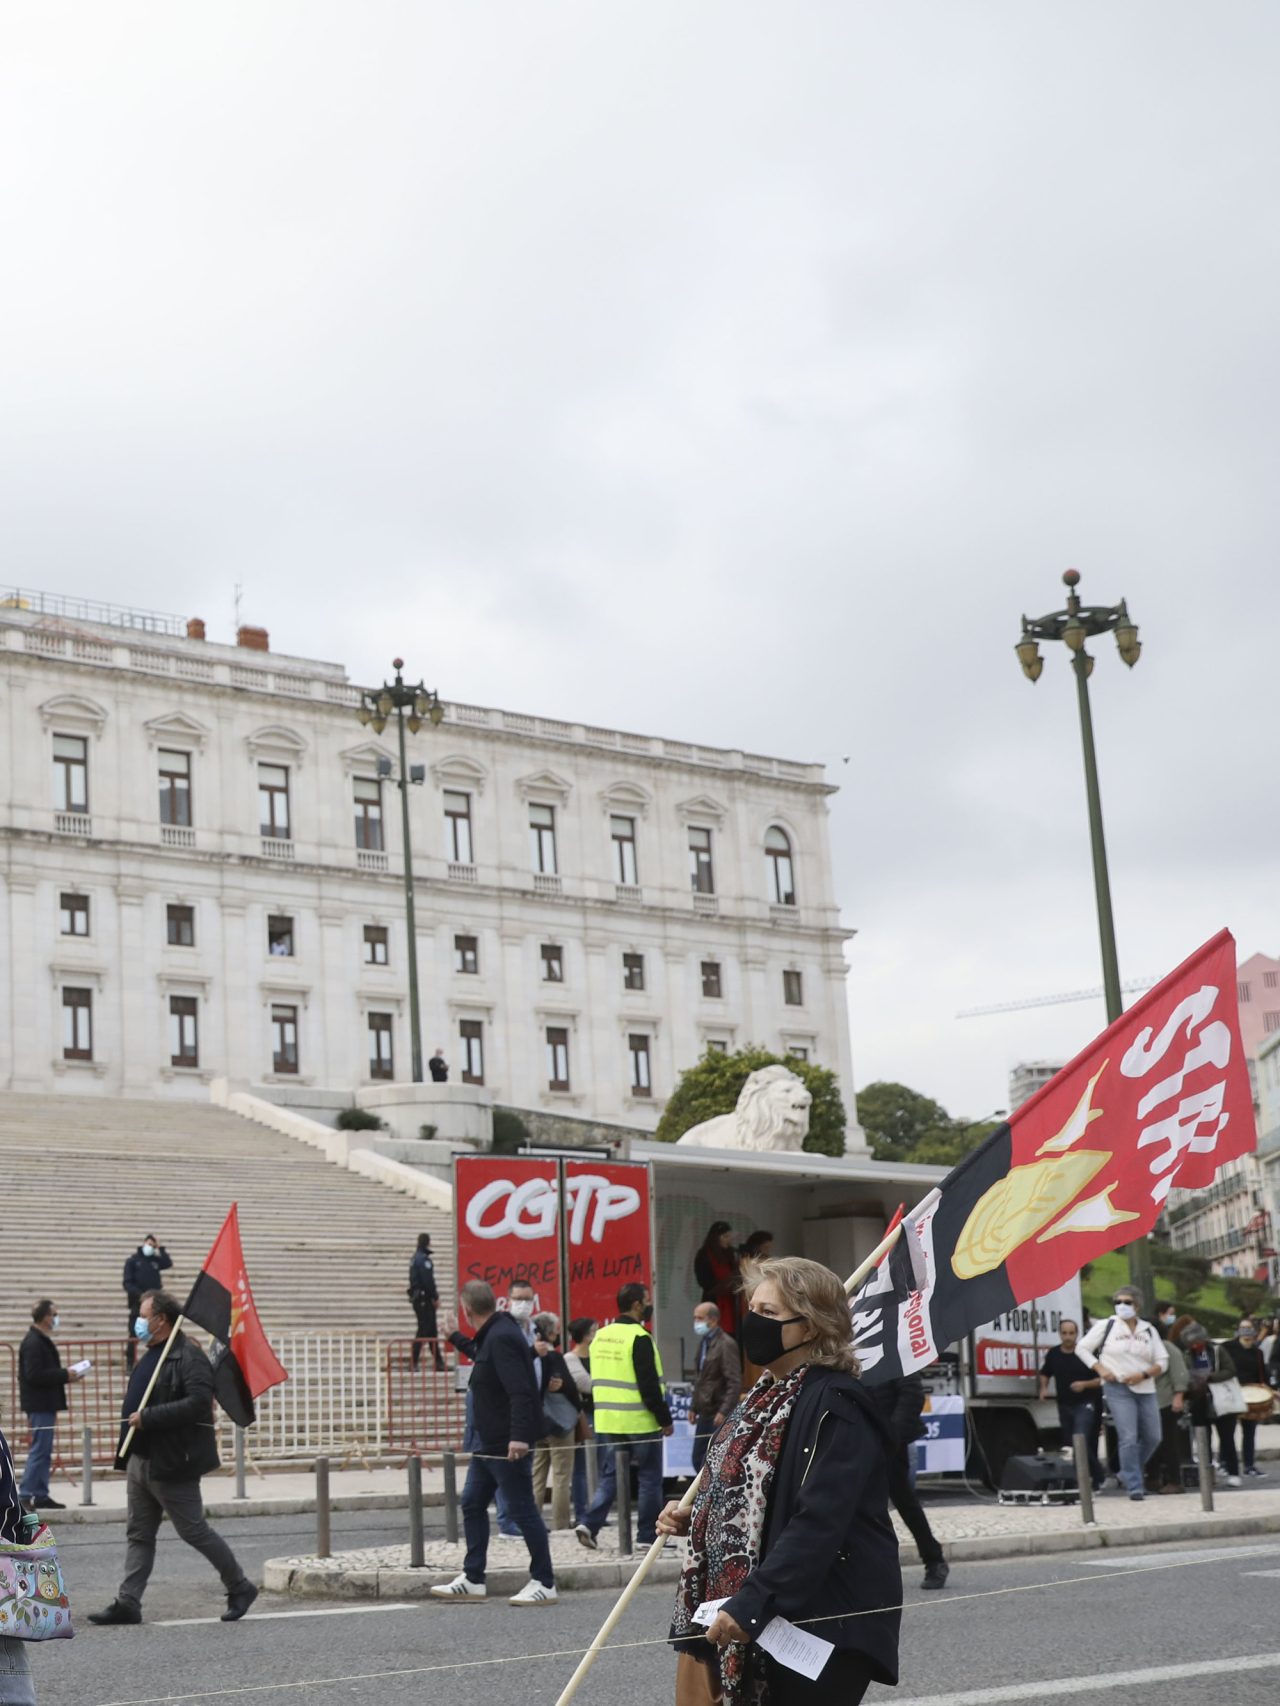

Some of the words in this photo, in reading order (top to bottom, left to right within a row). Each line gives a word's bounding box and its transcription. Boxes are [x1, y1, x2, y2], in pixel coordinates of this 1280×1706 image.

[465, 1174, 640, 1245] CGTP
[466, 1258, 556, 1287] SEMPRE
[571, 1261, 596, 1283] NA
[602, 1252, 643, 1278] LUTA
[984, 1347, 1019, 1372] QUEM
